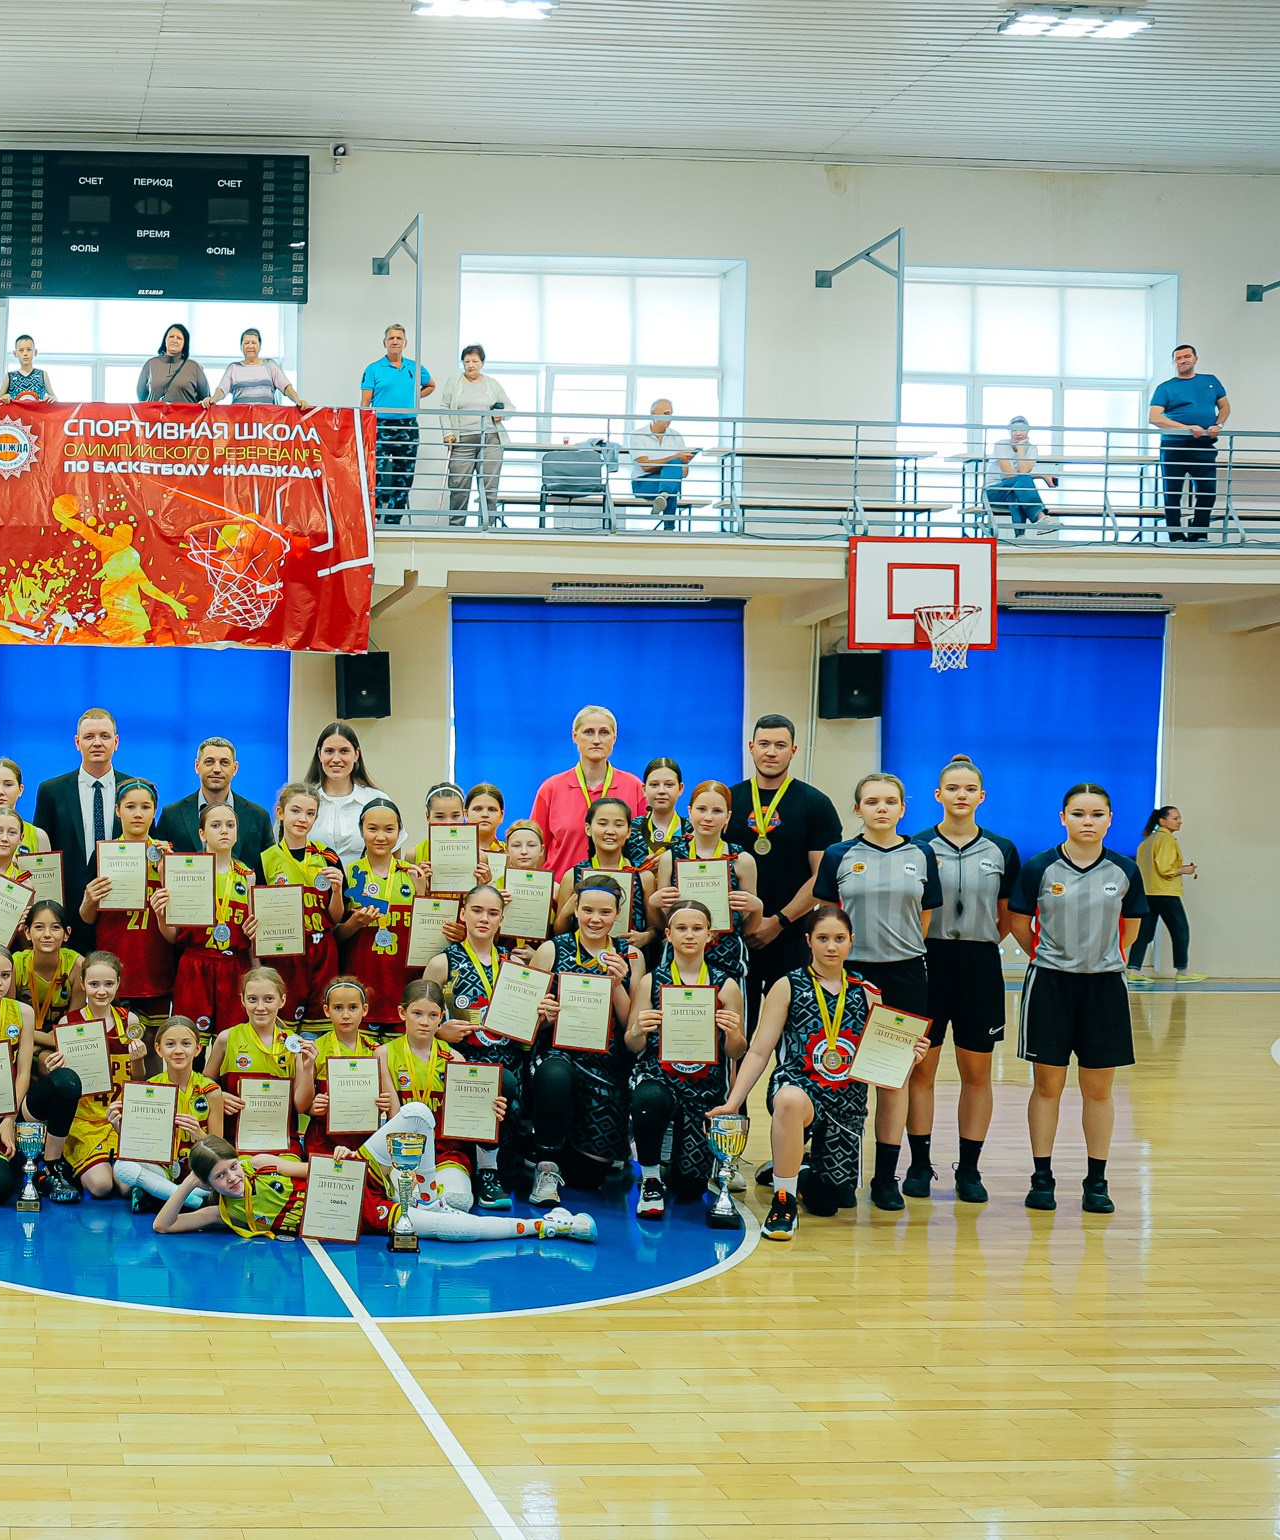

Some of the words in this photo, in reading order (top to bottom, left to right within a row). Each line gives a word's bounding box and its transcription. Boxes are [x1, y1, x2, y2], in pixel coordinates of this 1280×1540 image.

[78, 176, 104, 185] СЧЕТ
[133, 177, 173, 188] ПЕРИОД
[217, 179, 243, 188] СЧЕТ
[136, 229, 170, 238] ВРЕМЯ
[70, 244, 100, 253] ФОЛЫ
[206, 247, 235, 256] ФОЛЫ
[63, 418, 229, 441] СПОРТИВНАЯ
[234, 422, 321, 445] ШКОЛА
[63, 442, 210, 461] ОЛИМПИЙСКОГО
[213, 445, 291, 462] РЕЗЕРВА
[63, 460, 90, 473] ПО
[92, 460, 210, 476] БАСКЕТБОЛУ
[212, 463, 322, 480] «НАДЕЖДА»
[438, 844, 470, 852] ДИПЛОМ
[107, 860, 139, 868] ДИПЛОМ
[173, 875, 206, 883] ДИПЛОМ
[686, 880, 721, 888] ДИПЛОМ
[513, 888, 545, 897] ДИПЛОМ
[234, 909, 244, 925] 5
[404, 911, 411, 927] 5
[504, 983, 537, 998] ДИПЛОМ
[568, 995, 603, 1005] ДИПЛОМ
[670, 1008, 706, 1017] ДИПЛОМ
[874, 1028, 912, 1045] ДИПЛОМ
[66, 1043, 99, 1054] ДИПЛОМ
[337, 1079, 371, 1087] ДИПЛОМ
[454, 1085, 490, 1094] ДИПЛОМ
[248, 1100, 282, 1108] ДИПЛОМ
[130, 1106, 166, 1115] ДИПЛОМ
[317, 1180, 355, 1191] ДИПЛОМ
